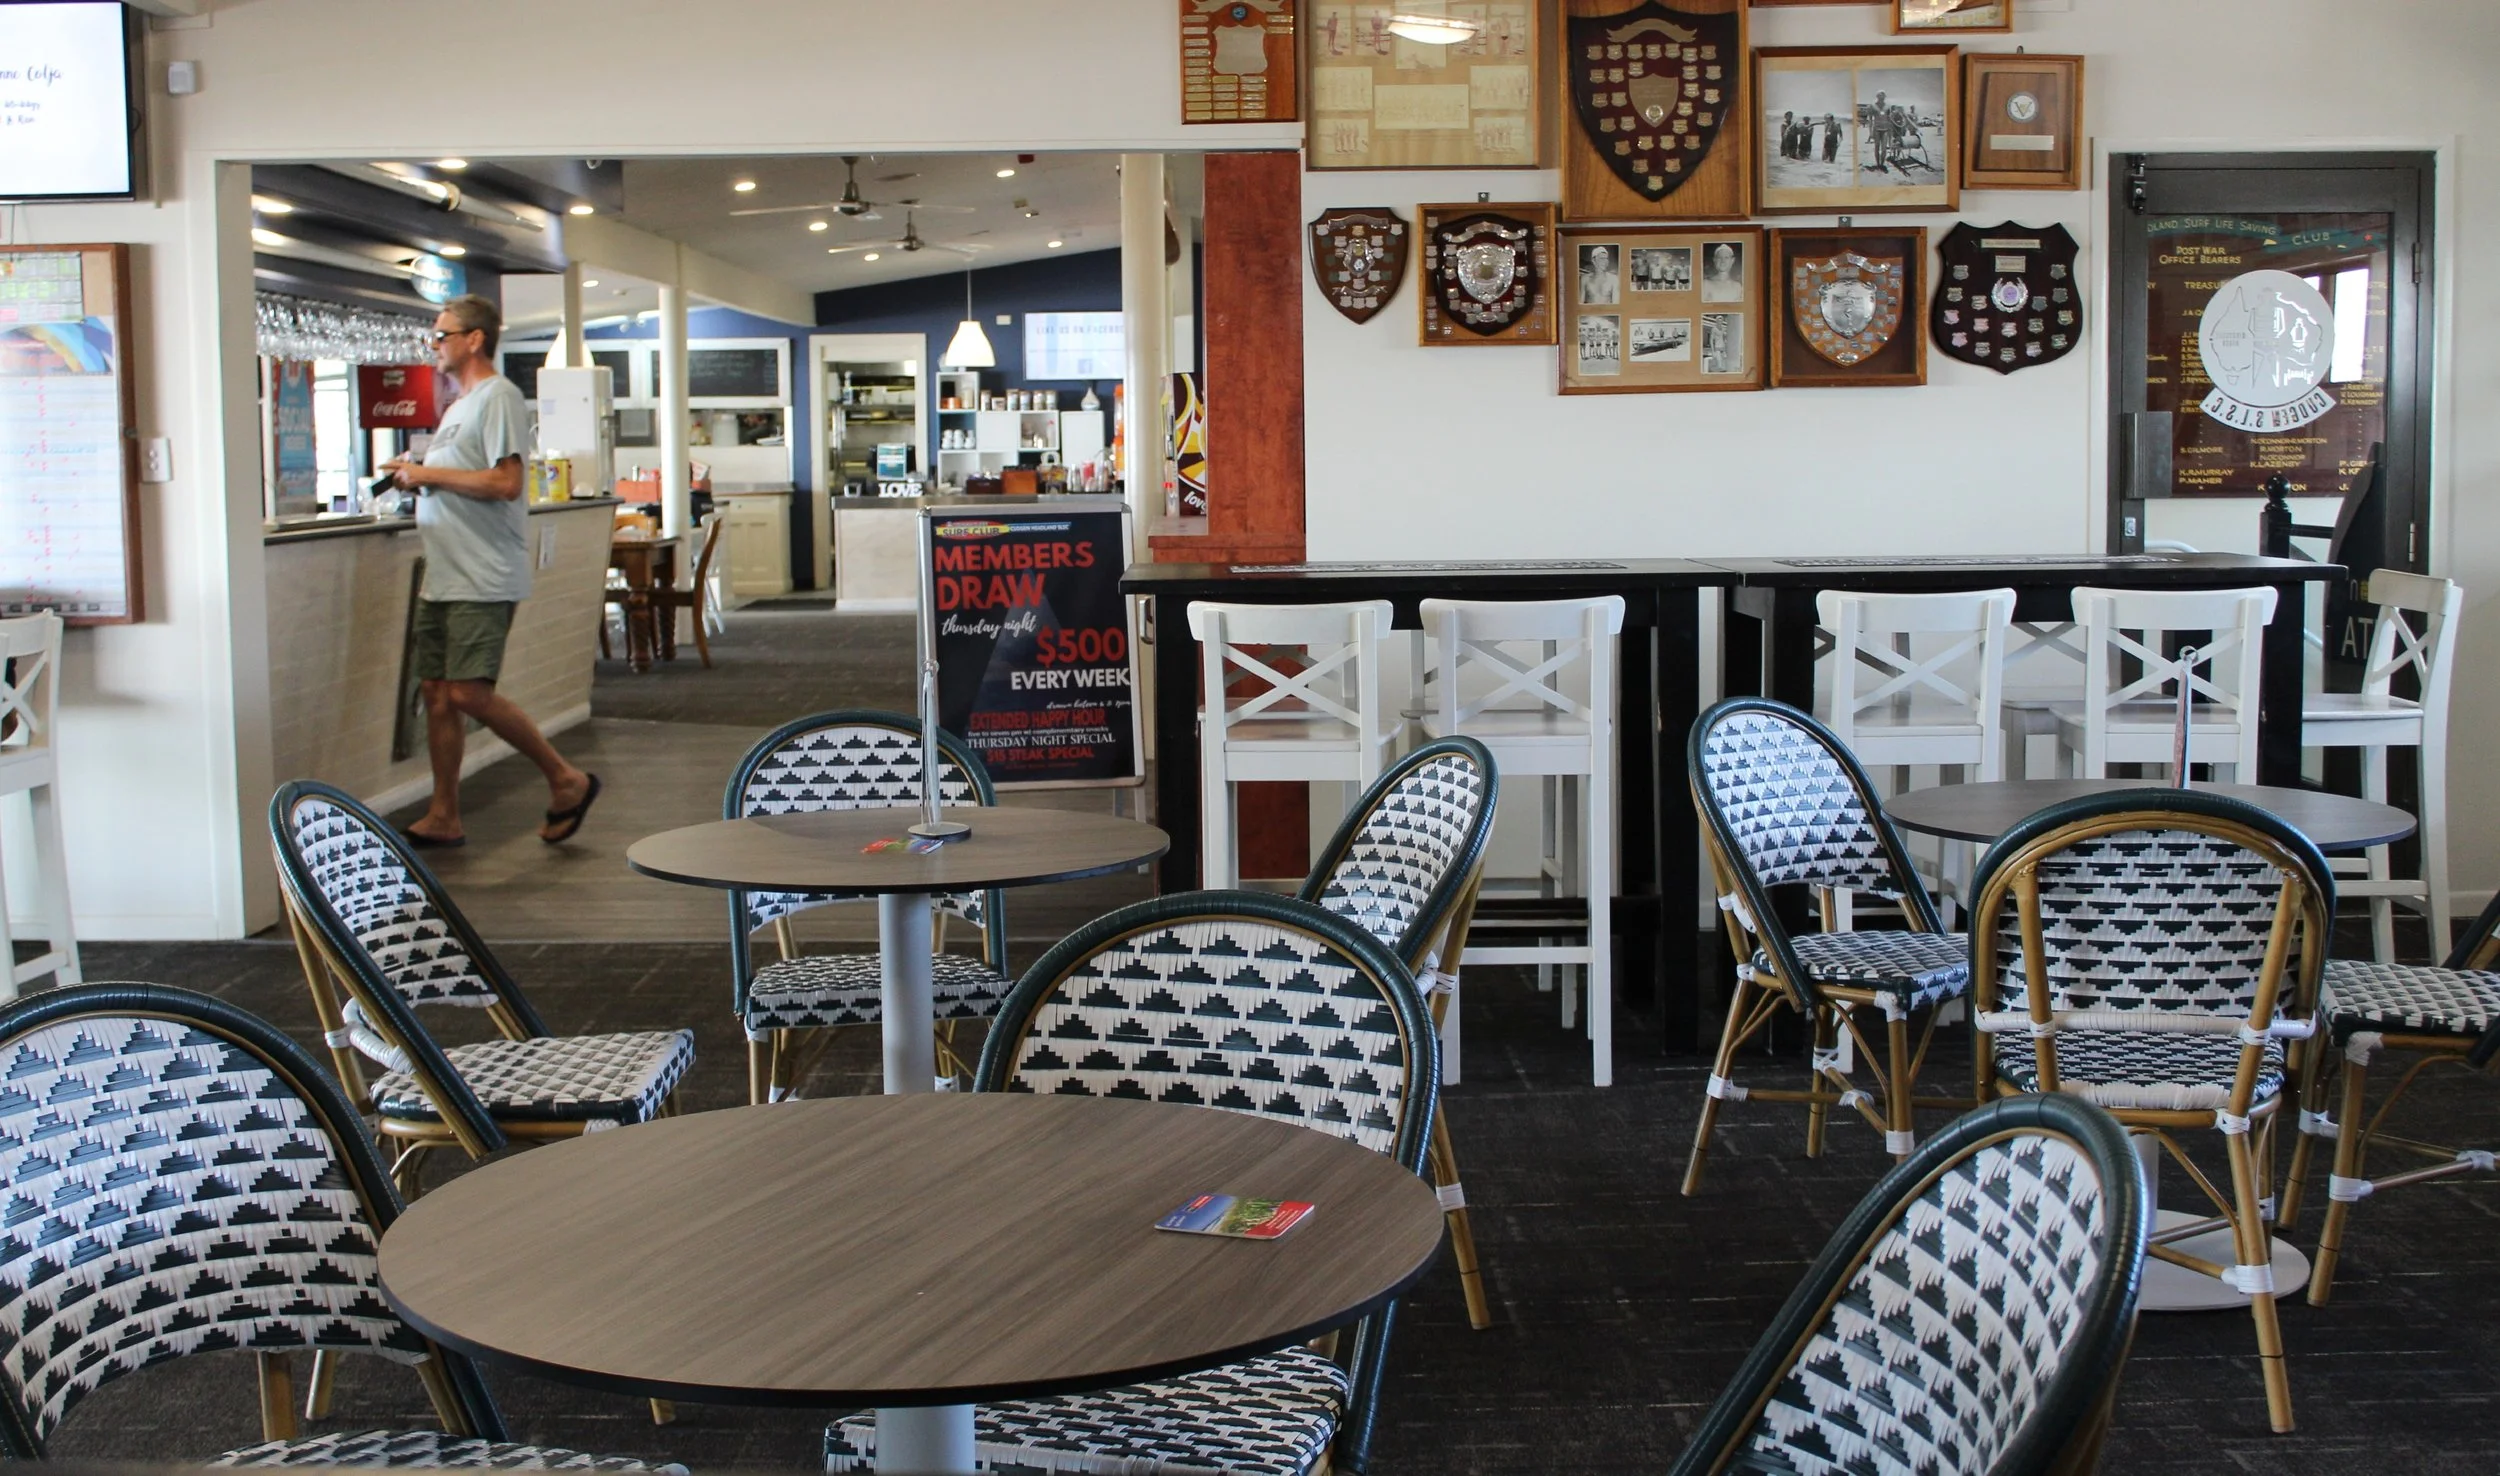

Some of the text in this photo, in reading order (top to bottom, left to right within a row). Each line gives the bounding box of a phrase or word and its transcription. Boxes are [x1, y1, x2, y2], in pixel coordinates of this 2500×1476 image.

[2184, 217, 2211, 229] SURF
[2215, 219, 2234, 229] LIFE
[2240, 221, 2277, 236] SAVING
[2292, 231, 2331, 246] CLUB
[2159, 255, 2241, 265] OFFICE BEARERS
[2176, 245, 2226, 255] POST WAR
[878, 482, 923, 498] LOVE
[942, 526, 1000, 537] SURF CLUB
[935, 541, 1095, 572] MEMBERS
[937, 573, 1046, 611] DRAW
[941, 611, 1037, 640] thursday night
[1036, 626, 1126, 668] $500
[1011, 668, 1131, 691] EVERY WEEK
[970, 708, 1107, 731] EXTENDED HAPPY HOUR
[965, 732, 1116, 749] THURSDAY NIGHT SPECIAL
[1008, 748, 1044, 761] STEAK
[1048, 747, 1094, 760] SPECIAL
